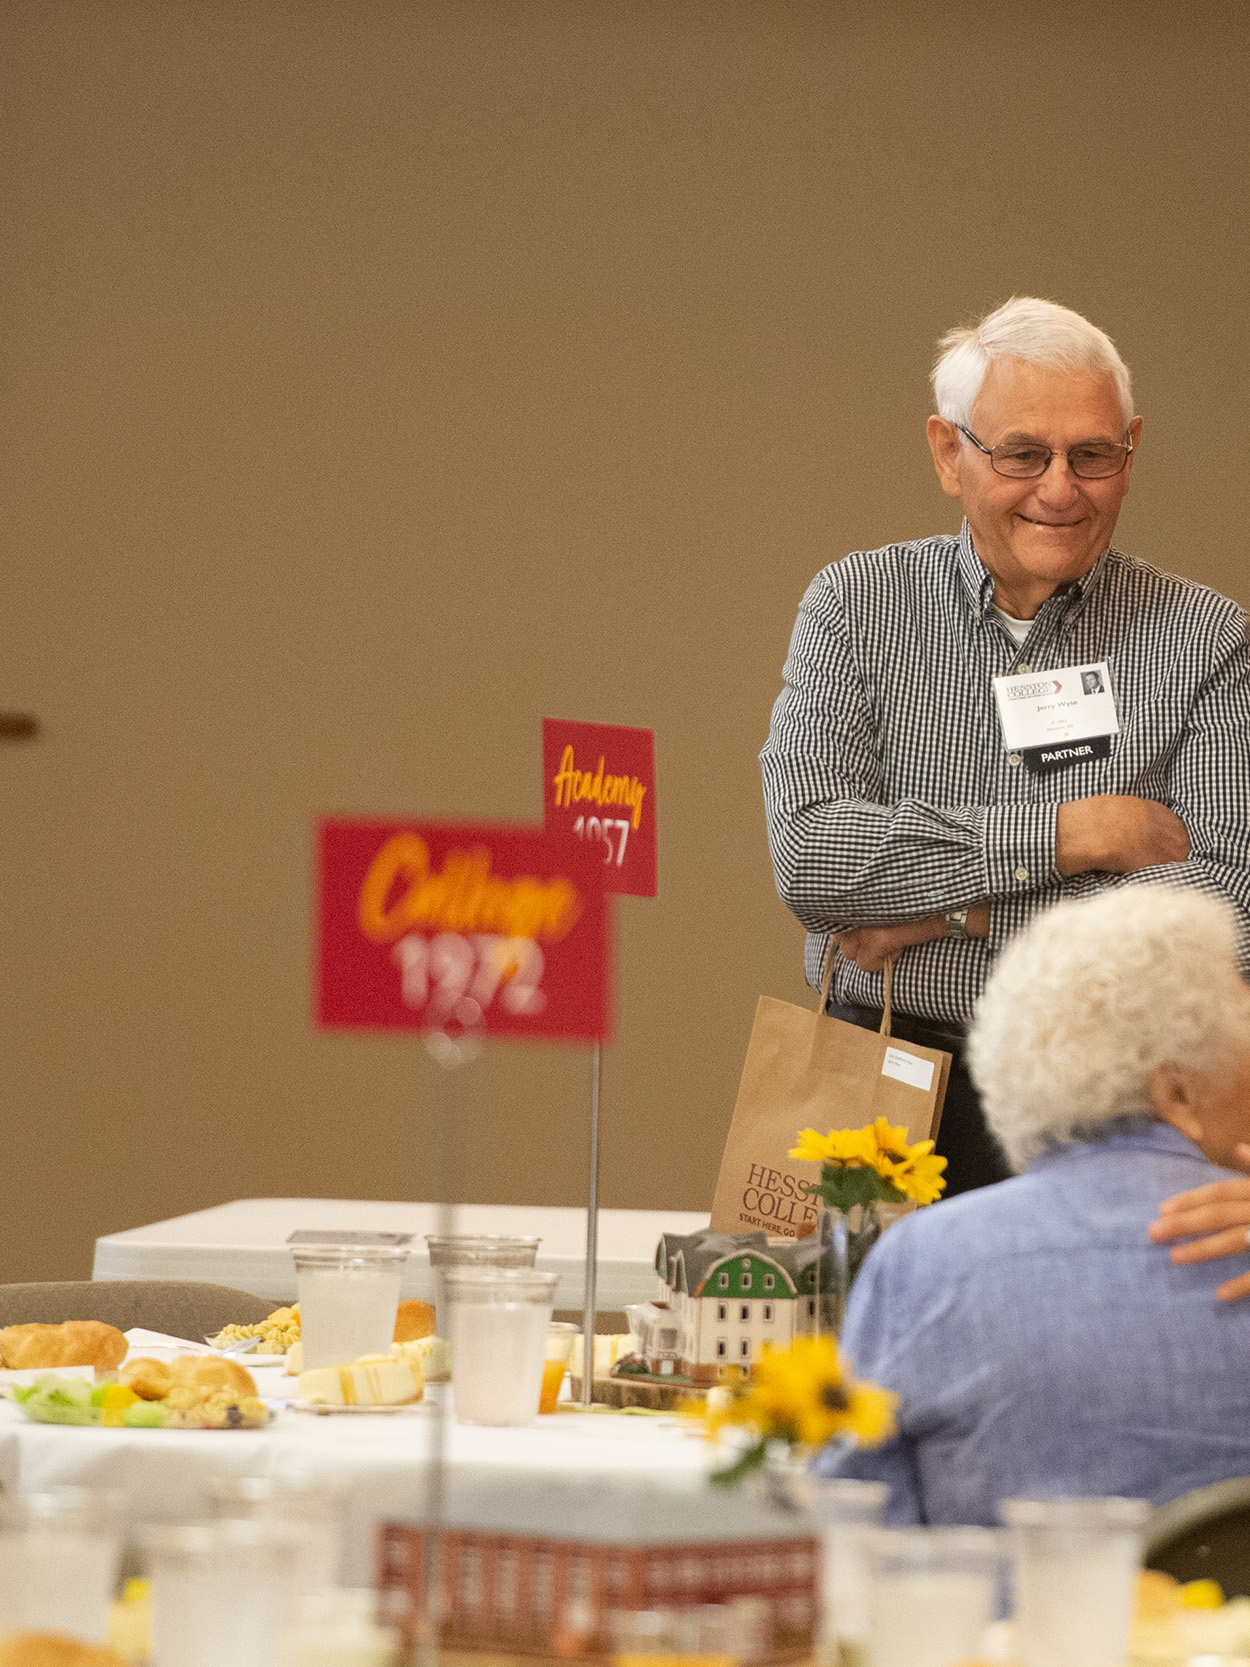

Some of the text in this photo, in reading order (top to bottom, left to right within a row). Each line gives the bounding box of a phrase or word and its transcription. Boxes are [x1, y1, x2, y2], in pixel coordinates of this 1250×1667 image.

[1037, 704, 1055, 712] Jerry
[1041, 745, 1093, 763] PARTNER
[554, 744, 647, 830] Academy
[359, 831, 582, 974] College
[394, 932, 545, 1013] 1972
[739, 1212, 763, 1227] START
[783, 1227, 796, 1238] GO
